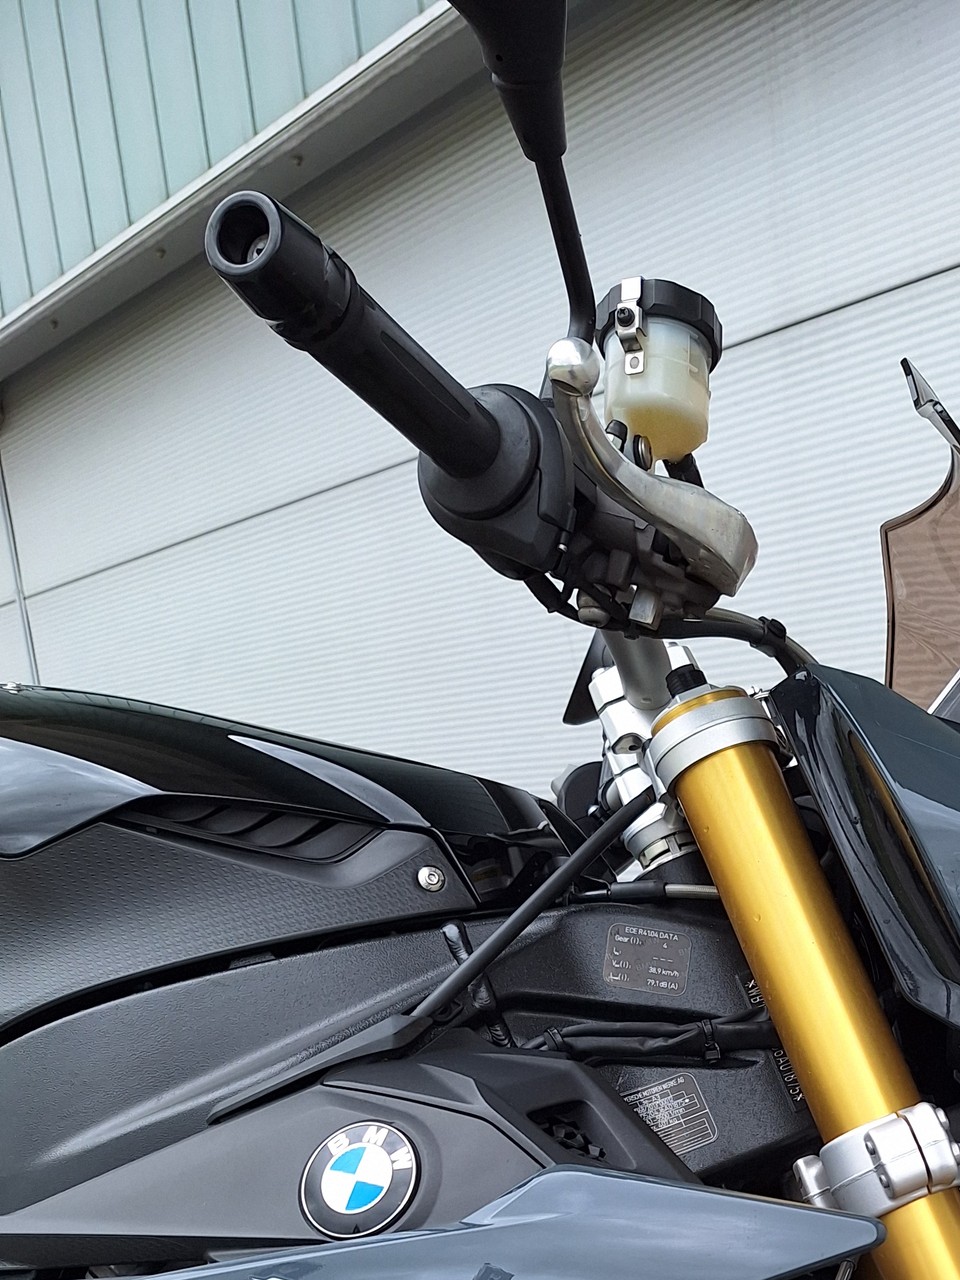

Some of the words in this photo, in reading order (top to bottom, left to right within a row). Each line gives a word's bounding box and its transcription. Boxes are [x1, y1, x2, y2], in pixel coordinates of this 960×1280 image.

[615, 934, 630, 942] Gear
[625, 927, 638, 935] ECE
[659, 932, 679, 941] DATA
[661, 969, 680, 977] km/h
[326, 1125, 413, 1170] BMW
